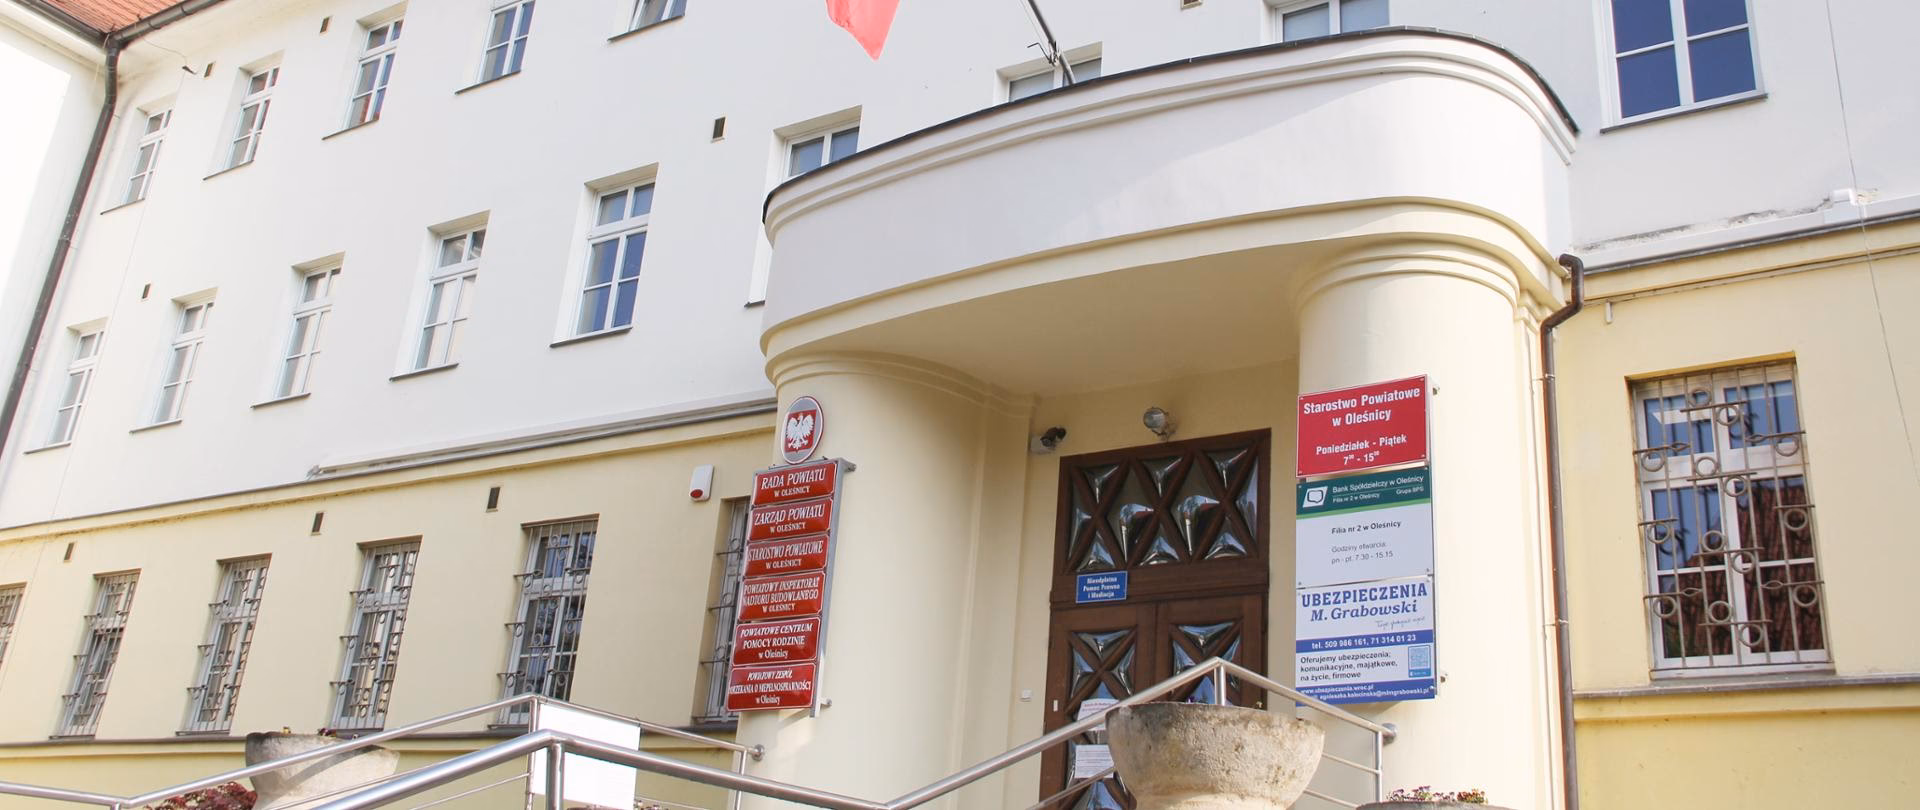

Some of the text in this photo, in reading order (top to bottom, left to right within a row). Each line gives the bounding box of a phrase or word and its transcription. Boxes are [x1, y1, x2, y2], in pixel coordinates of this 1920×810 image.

[1304, 388, 1420, 415] Starostwo Powiatowe
[1332, 409, 1392, 427] w Oleśnicy
[1316, 440, 1369, 455] Poniedziałek
[1379, 434, 1407, 447] Piątek
[761, 468, 826, 490] RADA POWIATU
[1333, 486, 1348, 494] Bank
[1349, 480, 1388, 491] Spółdzielczy
[1396, 475, 1424, 485] Oleśnicy
[781, 485, 810, 496] OLEŚNICY
[1396, 488, 1412, 496] Grupa
[754, 504, 825, 525] ZARZĄD POWIATU
[770, 521, 806, 534] W OLEŚNICY
[1331, 527, 1346, 535] Filia
[1356, 524, 1362, 532] 2
[748, 540, 824, 561] STAROSTWO POWIATOWE
[1331, 544, 1357, 553] Godziny
[772, 558, 802, 569] OLEŚNICY
[744, 577, 820, 595] POWIATOWY INSPEKTORAT
[770, 589, 818, 604] BUDOWLANEGO
[1302, 583, 1427, 607] UBEZPIECZENIA
[762, 605, 768, 613] W
[1311, 600, 1417, 621] M. Grabowski
[740, 623, 813, 638] POWIATOWE CENTRUM
[743, 635, 805, 649] POMOCY RODZINIE
[1371, 636, 1379, 644] 71
[1381, 635, 1395, 643] 314
[764, 649, 788, 659] Oleśnicy
[1301, 655, 1336, 664] Oferujemy
[1301, 663, 1355, 673] komunikacyjne,
[1310, 672, 1331, 682] życie,
[1332, 671, 1361, 679] firmowe
